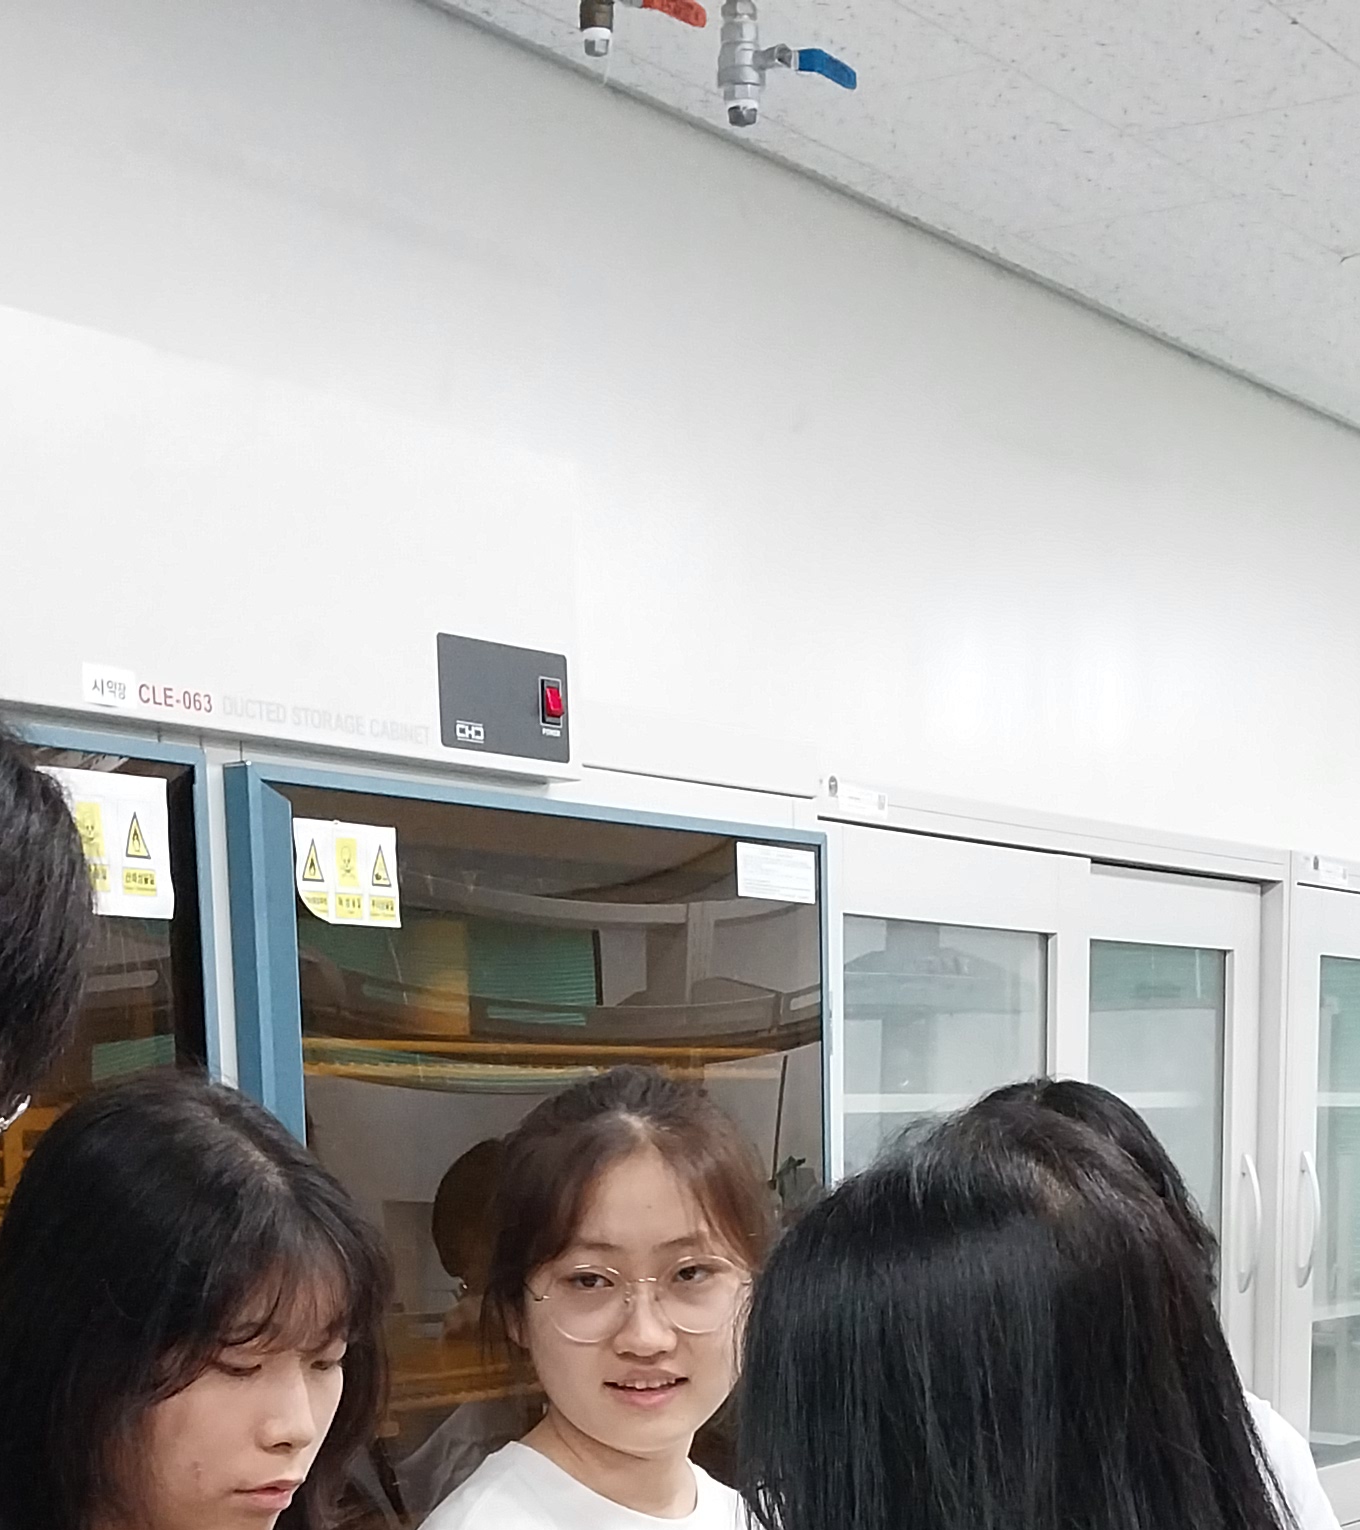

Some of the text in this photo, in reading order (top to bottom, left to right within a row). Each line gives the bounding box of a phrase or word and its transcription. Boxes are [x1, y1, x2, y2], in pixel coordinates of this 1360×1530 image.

[91, 678, 127, 700] 시약장
[138, 683, 213, 713] CLE-063
[291, 706, 366, 736] STORAGE
